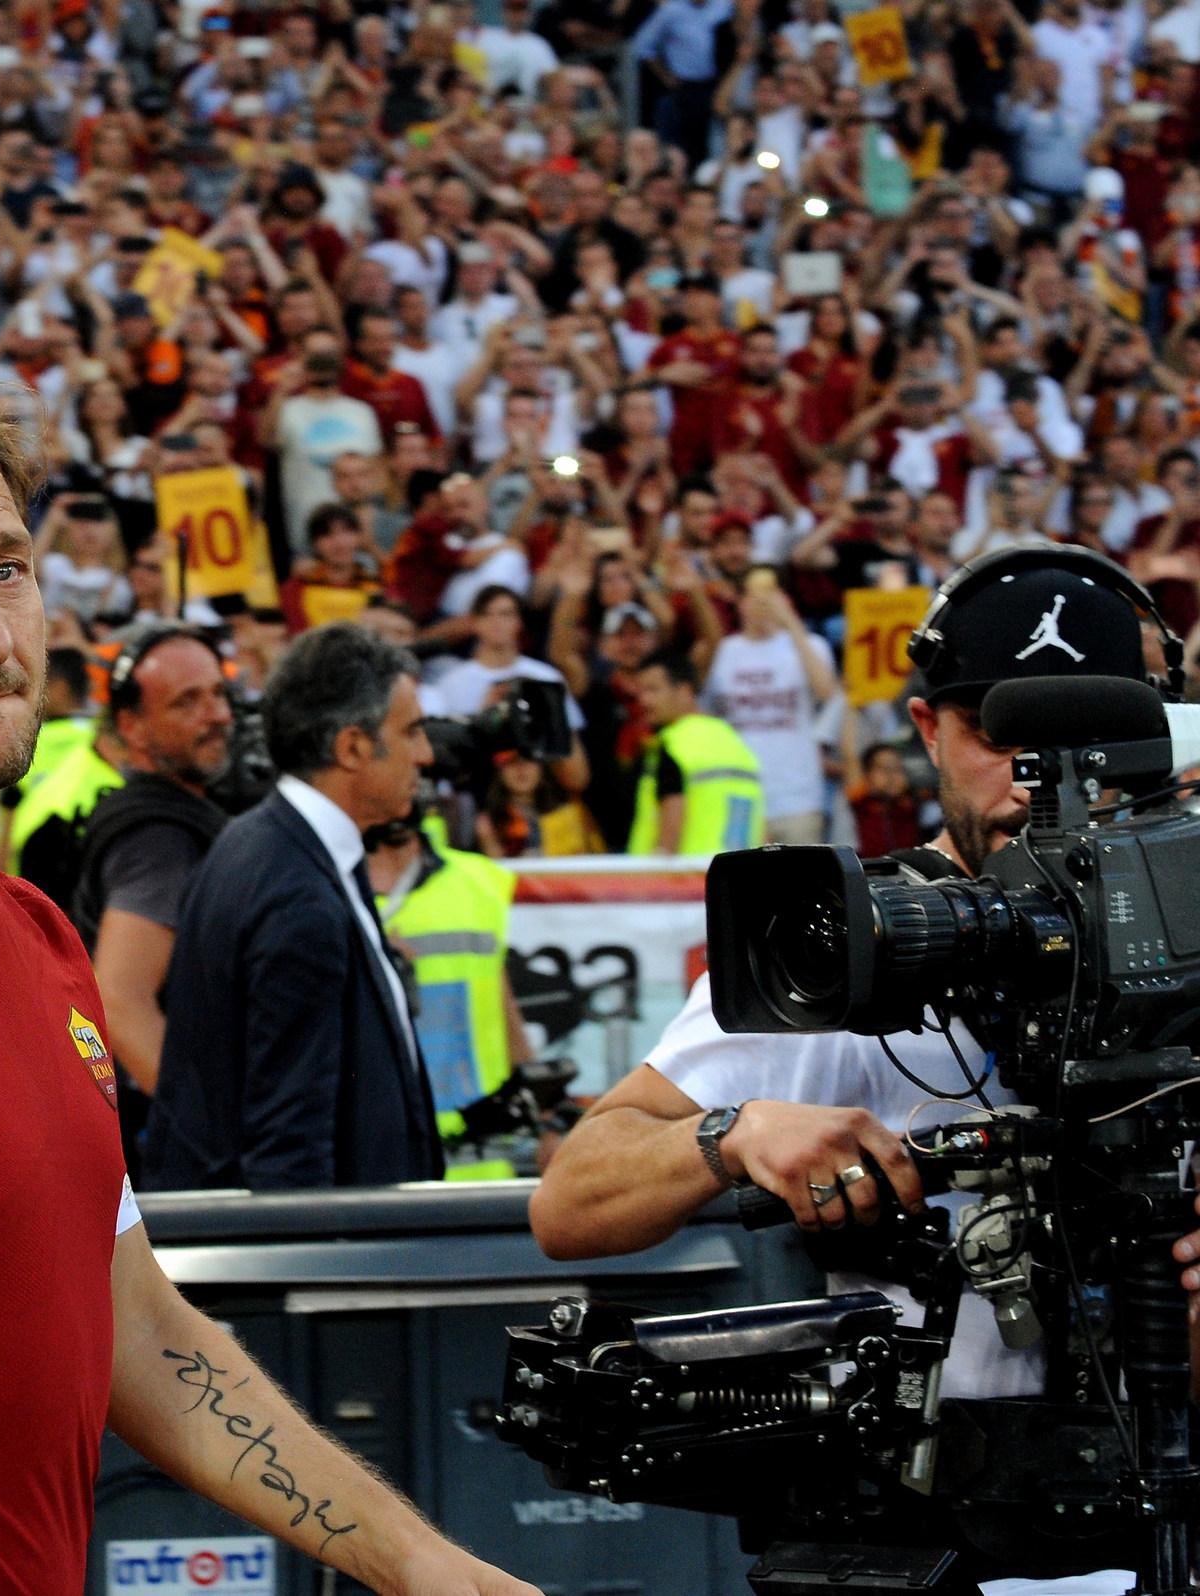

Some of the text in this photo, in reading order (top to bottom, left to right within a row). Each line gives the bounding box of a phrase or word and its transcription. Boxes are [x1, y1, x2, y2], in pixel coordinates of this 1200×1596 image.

[171, 508, 242, 570] 10
[855, 623, 919, 680] 10
[91, 1062, 115, 1080] ROMA
